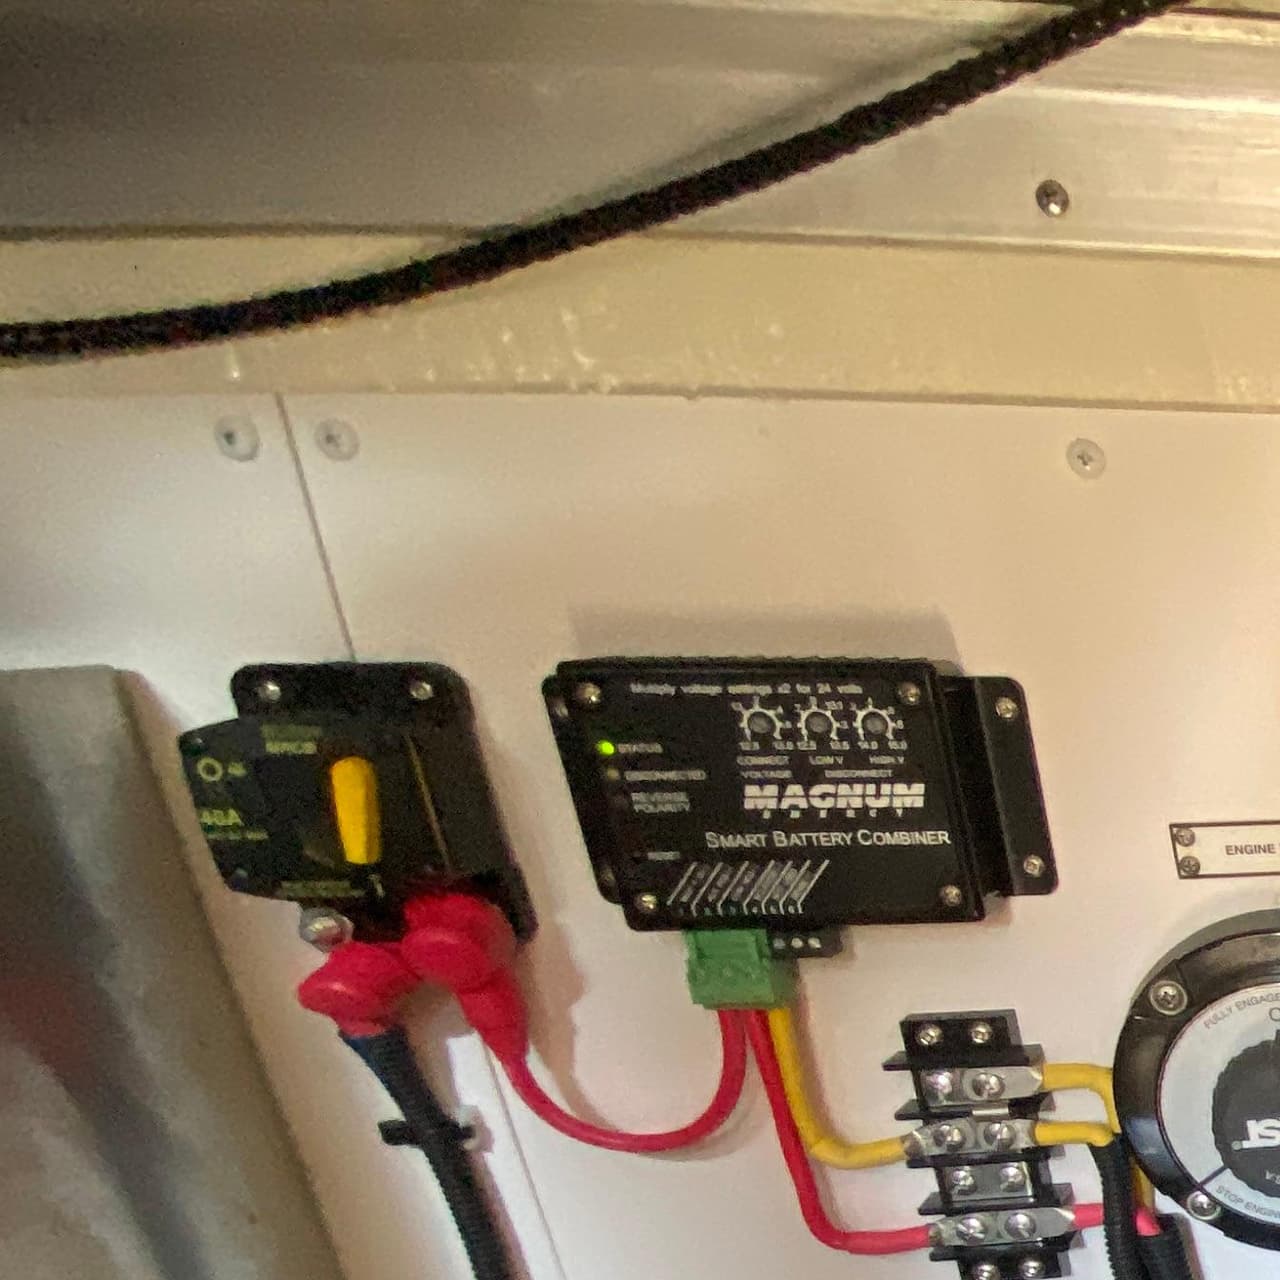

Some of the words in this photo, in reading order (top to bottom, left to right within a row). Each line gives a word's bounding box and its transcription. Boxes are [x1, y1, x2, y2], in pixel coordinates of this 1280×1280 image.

[743, 783, 925, 810] MAGNUM
[705, 831, 767, 849] SMART
[772, 830, 852, 848] BATTERY
[857, 828, 951, 846] COMBINER
[1224, 843, 1277, 856] ENGINE
[1203, 1004, 1233, 1030] FULLY
[1215, 1185, 1243, 1205] STOP
